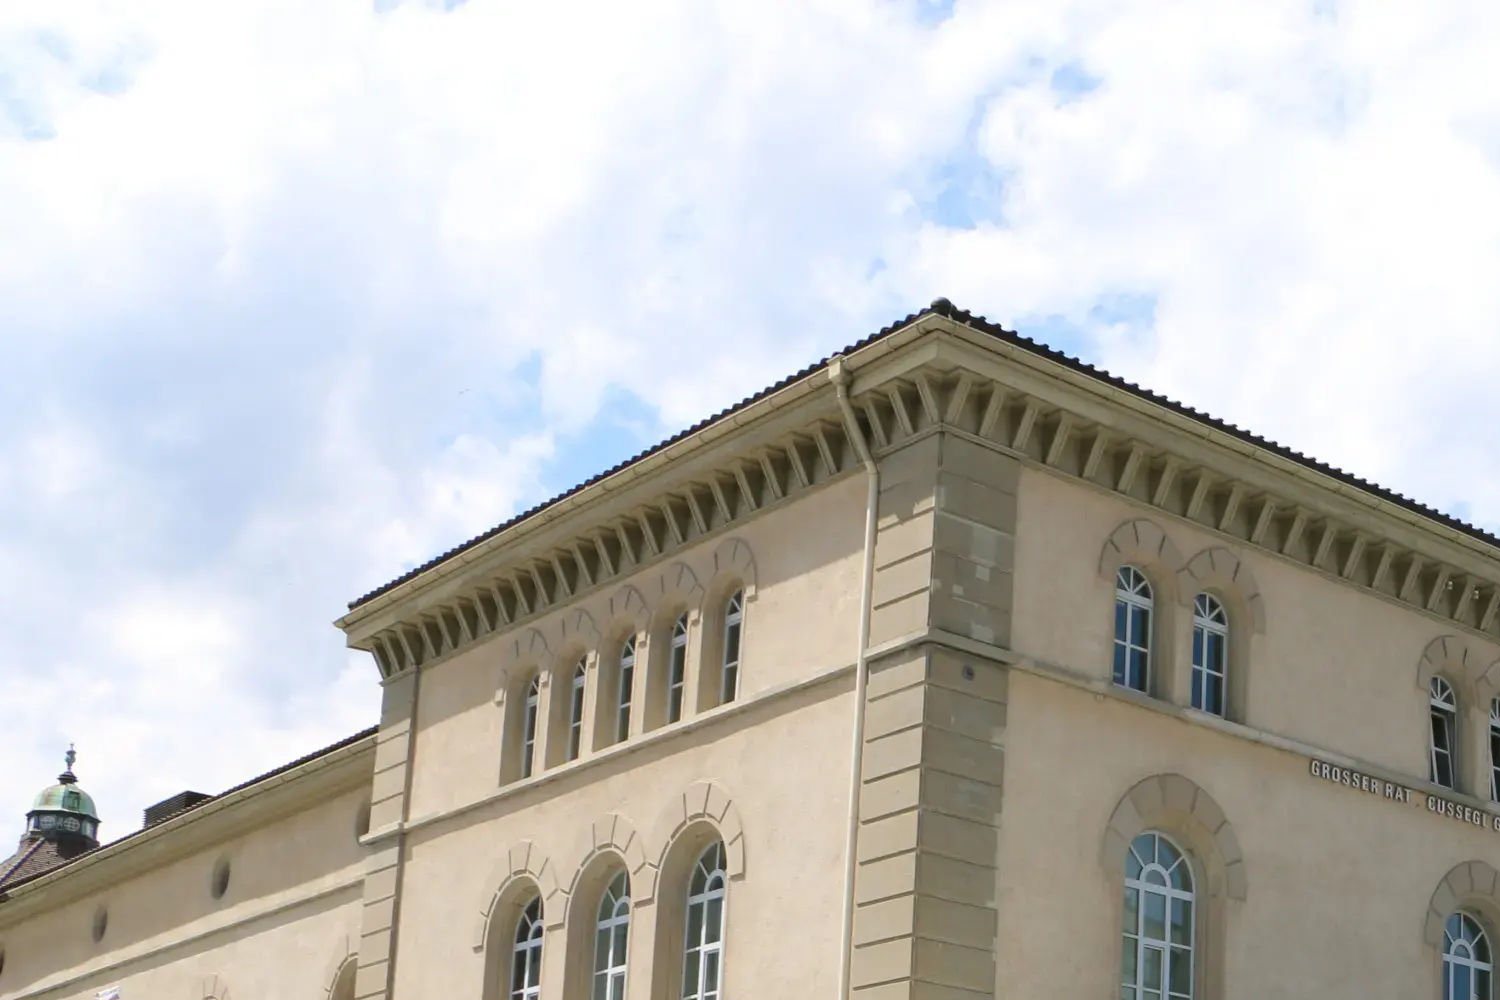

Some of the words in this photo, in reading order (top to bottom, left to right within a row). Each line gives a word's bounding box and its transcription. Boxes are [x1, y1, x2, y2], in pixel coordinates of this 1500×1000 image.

[1310, 759, 1379, 794] GROSSER
[1385, 782, 1412, 803] RAT
[1427, 795, 1489, 829] CUSSEGL
